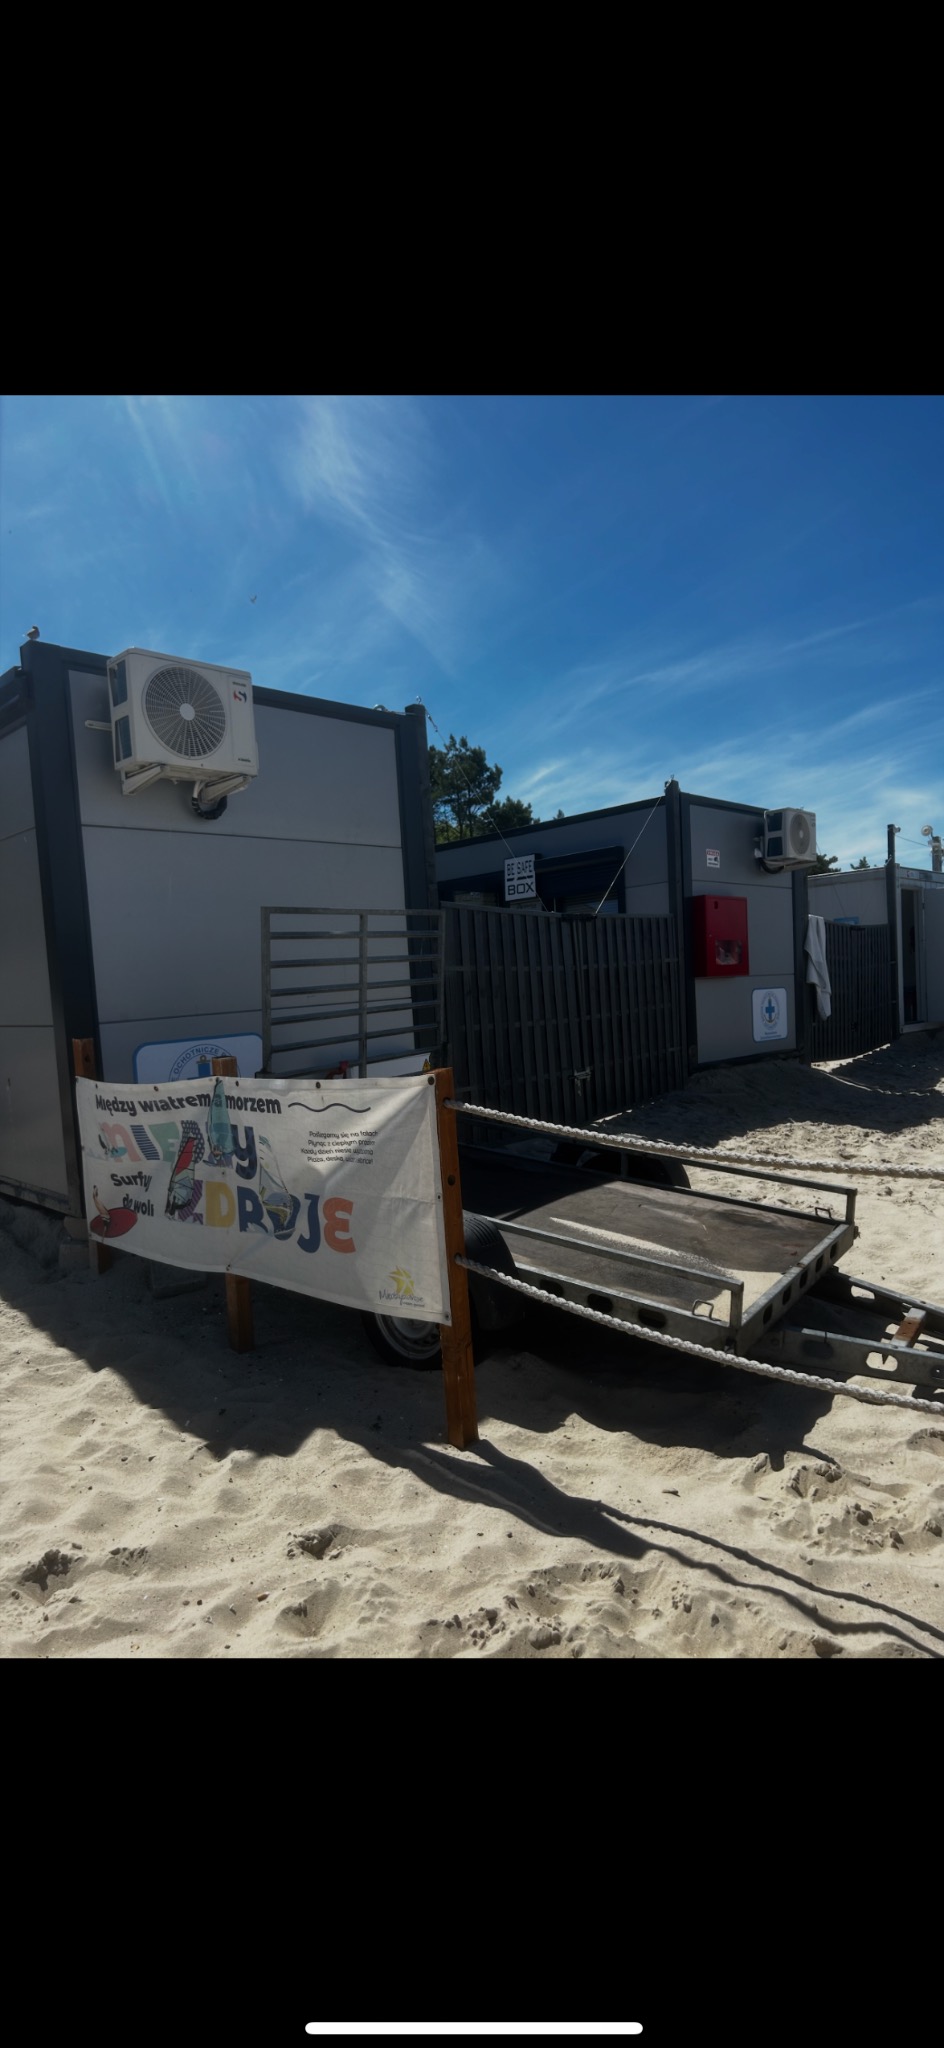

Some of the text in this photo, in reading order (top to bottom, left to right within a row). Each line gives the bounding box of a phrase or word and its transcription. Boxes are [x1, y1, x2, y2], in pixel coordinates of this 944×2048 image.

[507, 860, 533, 876] BE SAFE
[508, 882, 534, 896] BOX
[173, 1046, 219, 1075] OCHOTNICZE
[95, 1094, 137, 1116] Między
[138, 1093, 210, 1113] wiatrem
[225, 1095, 282, 1114] morzem
[134, 1199, 154, 1217] woli
